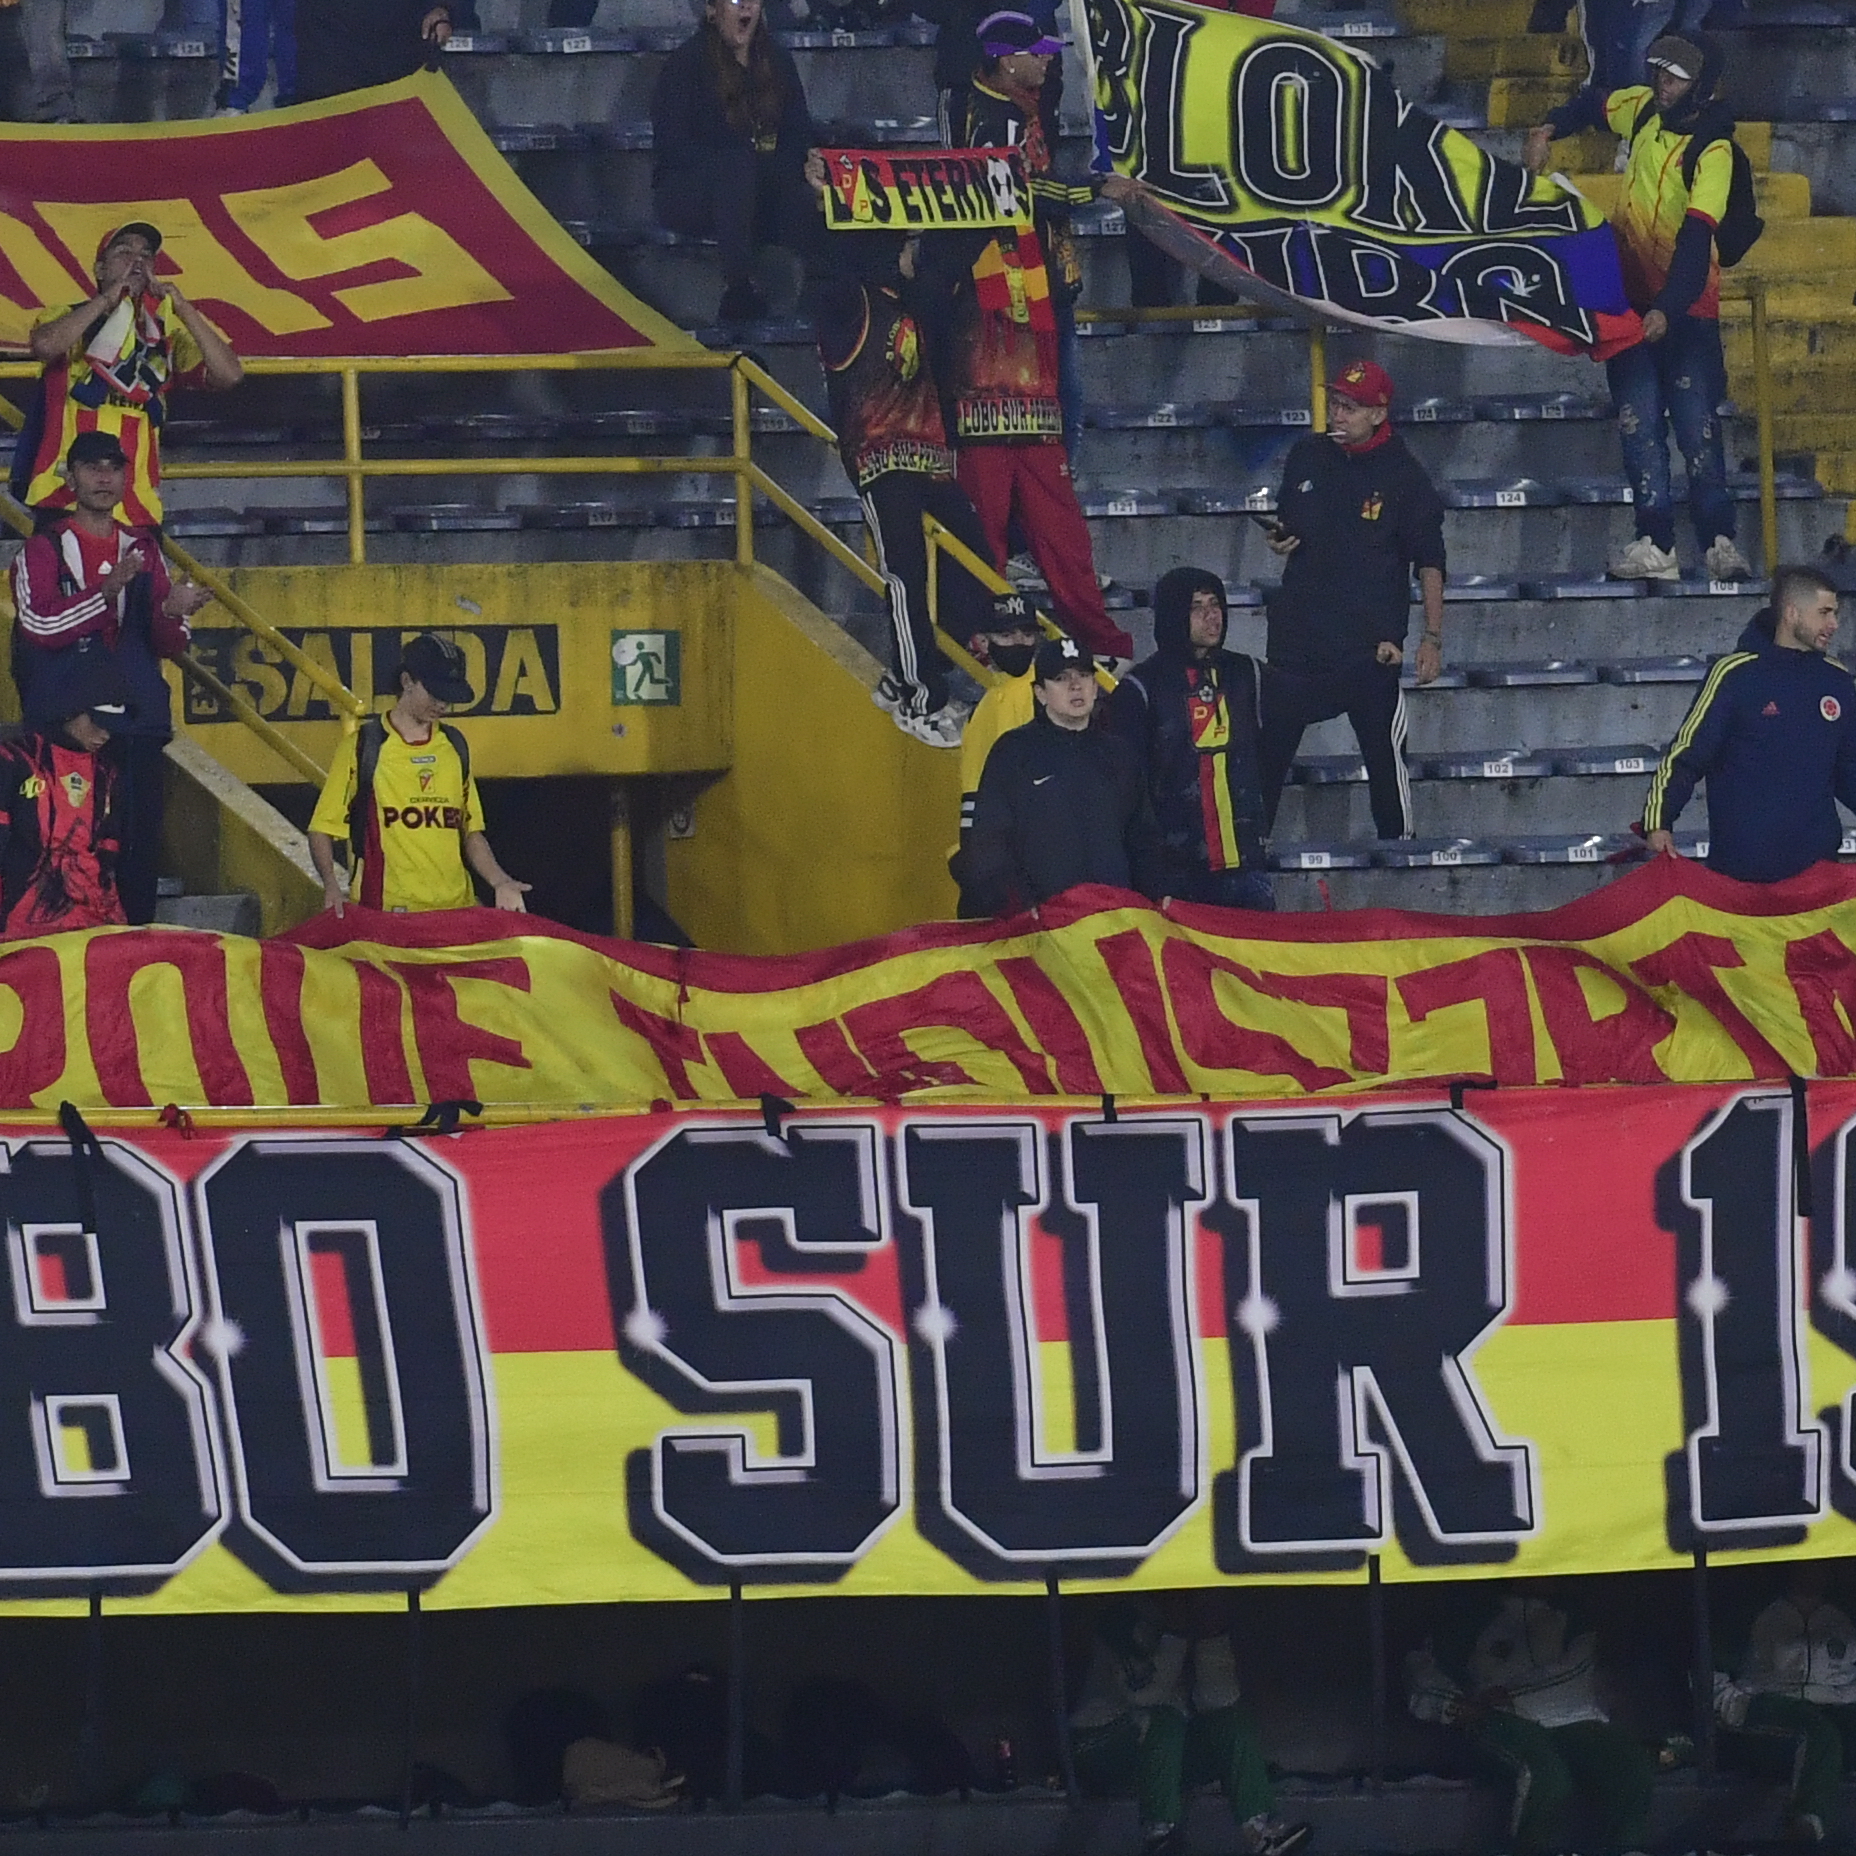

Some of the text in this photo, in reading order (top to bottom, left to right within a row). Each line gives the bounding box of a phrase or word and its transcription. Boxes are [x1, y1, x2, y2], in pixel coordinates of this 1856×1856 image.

[832, 156, 1033, 227] LS ETERNS
[1283, 410, 1306, 422] 123
[1500, 492, 1521, 503] 124
[1109, 500, 1133, 513] 121
[230, 626, 557, 718] SALDA
[1487, 762, 1509, 774] 102
[1618, 760, 1641, 770] 103
[1307, 854, 1324, 865] 99
[1436, 852, 1460, 862] 100
[1573, 849, 1597, 859] 101
[609, 1106, 1536, 1584] SUR
